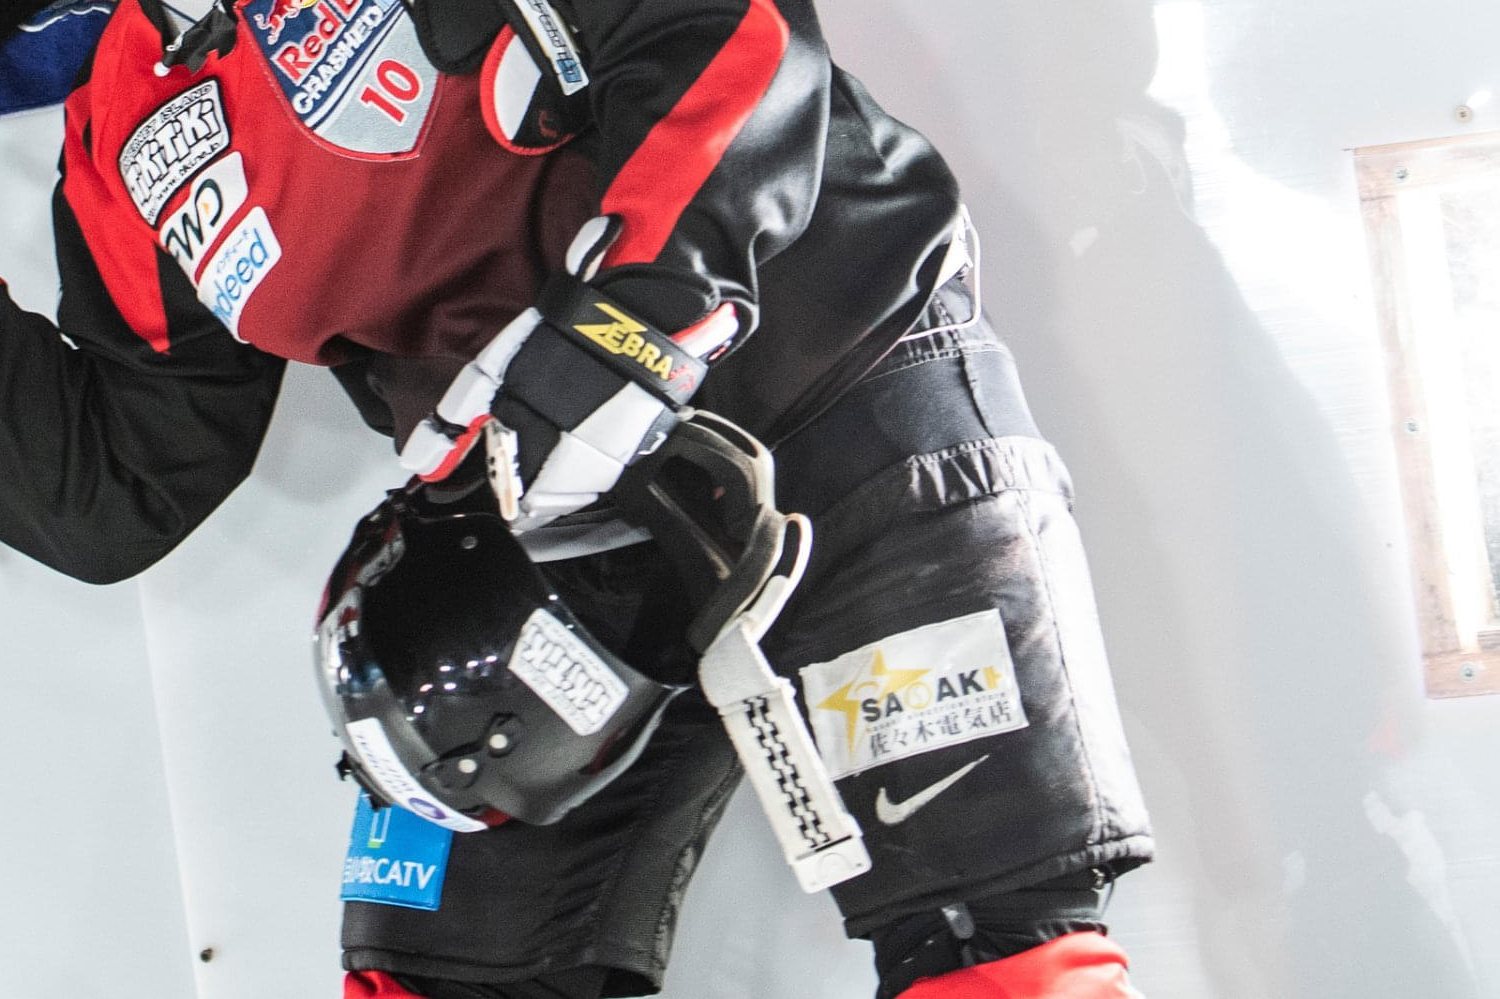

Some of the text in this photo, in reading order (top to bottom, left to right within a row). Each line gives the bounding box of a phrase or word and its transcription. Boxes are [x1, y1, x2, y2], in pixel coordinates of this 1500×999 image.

[271, 1, 346, 86] Red
[292, 5, 384, 114] CRASHED
[360, 59, 422, 127] 10
[572, 302, 673, 380] ZEBRA
